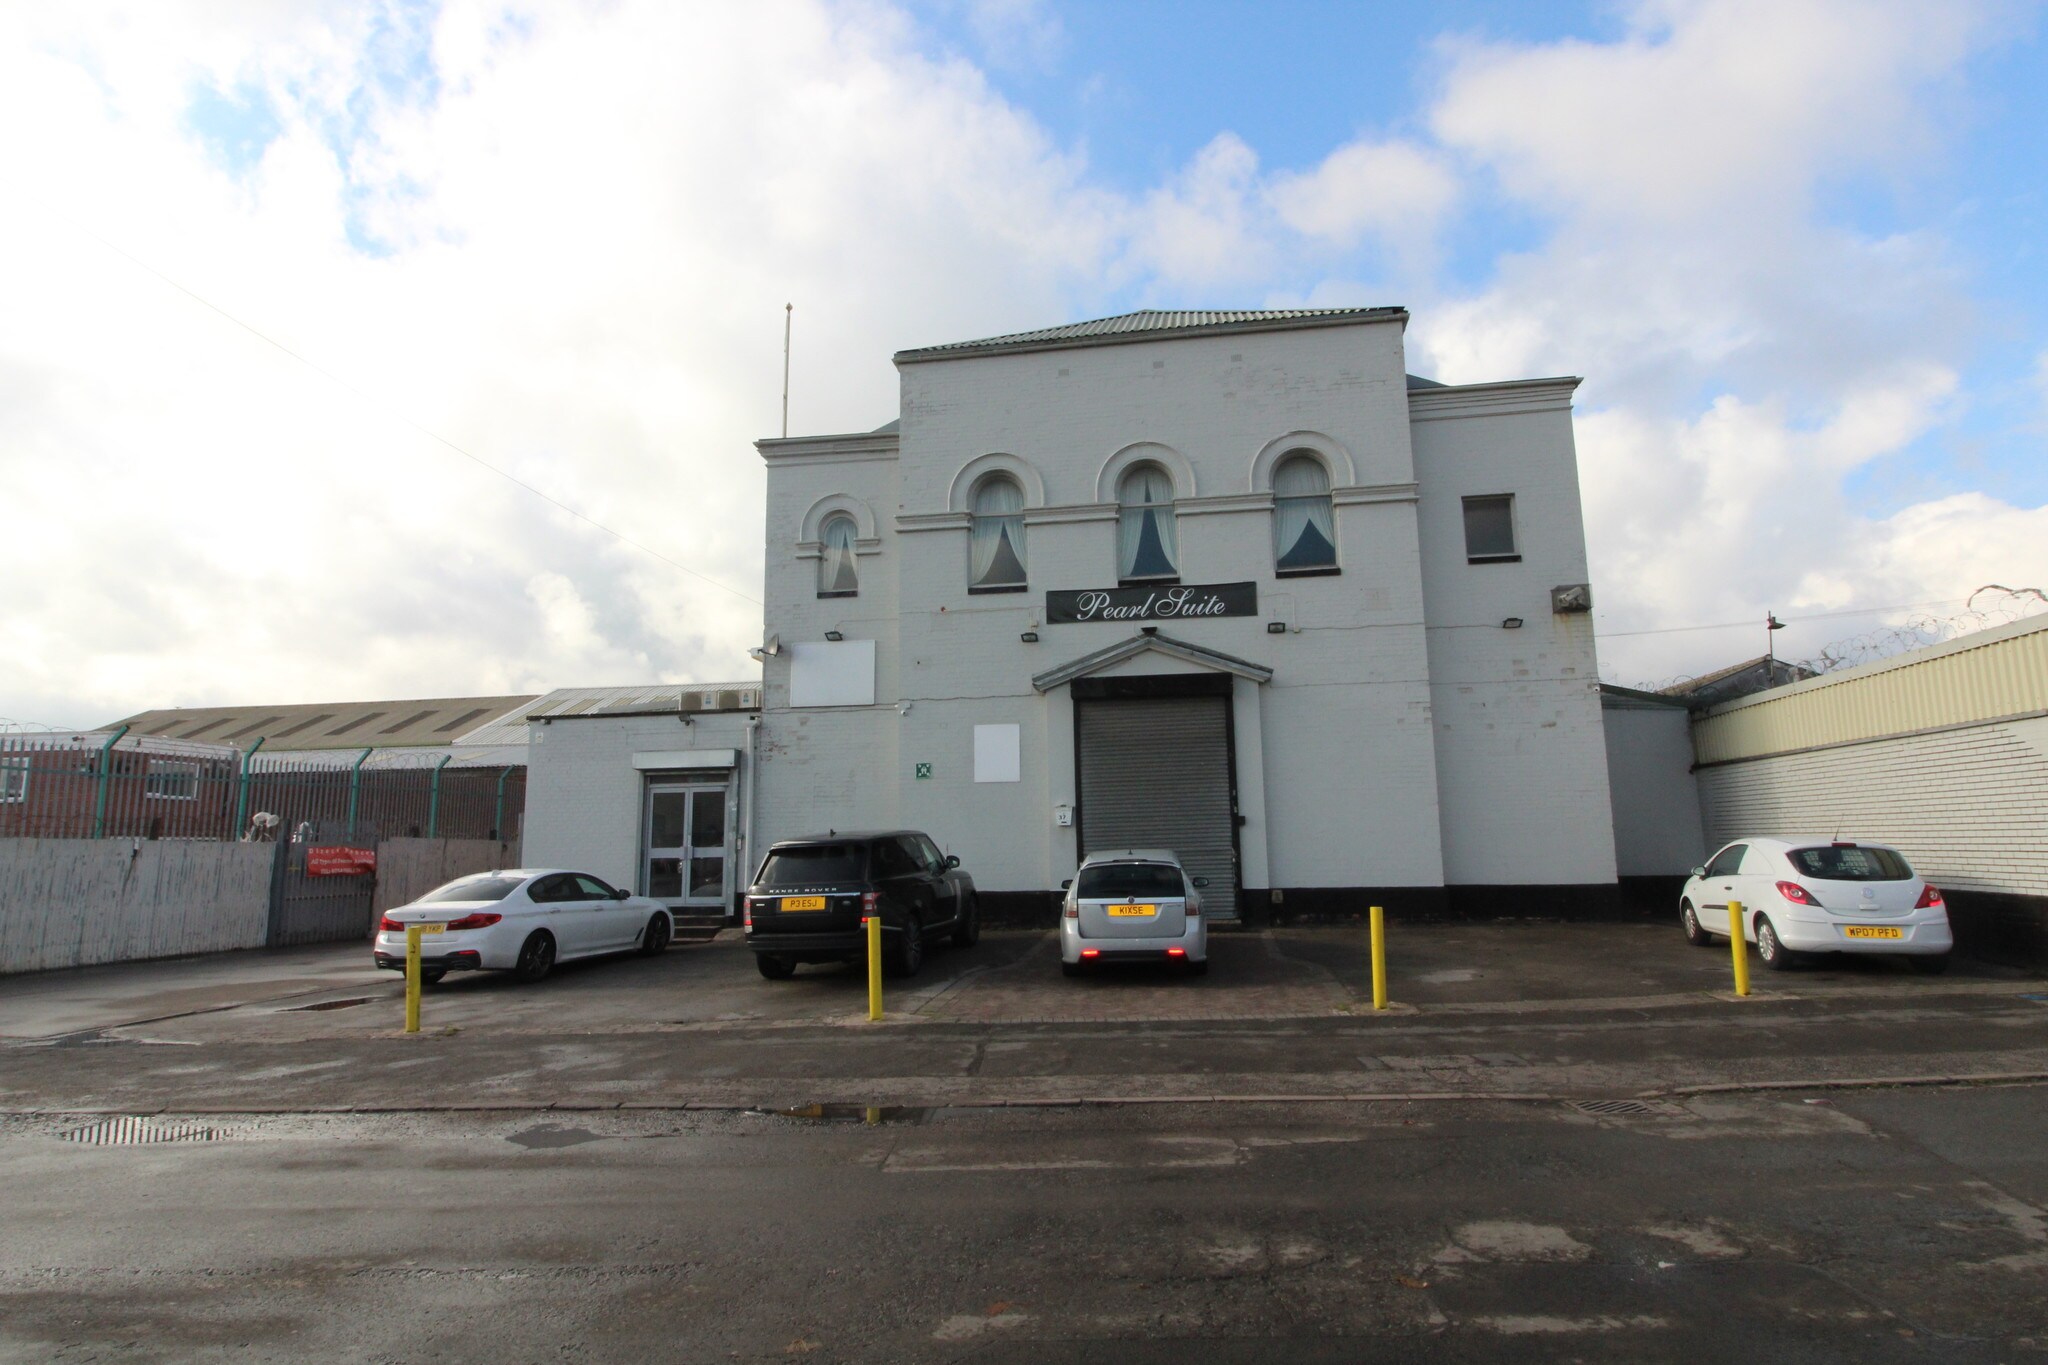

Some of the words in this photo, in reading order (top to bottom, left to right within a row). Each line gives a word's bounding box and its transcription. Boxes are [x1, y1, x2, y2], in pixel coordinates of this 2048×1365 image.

[1076, 591, 1155, 621] Pearl
[1155, 587, 1226, 617] Suite
[790, 900, 800, 908] P3
[801, 899, 817, 907] ESJ
[1877, 928, 1898, 938] PFD
